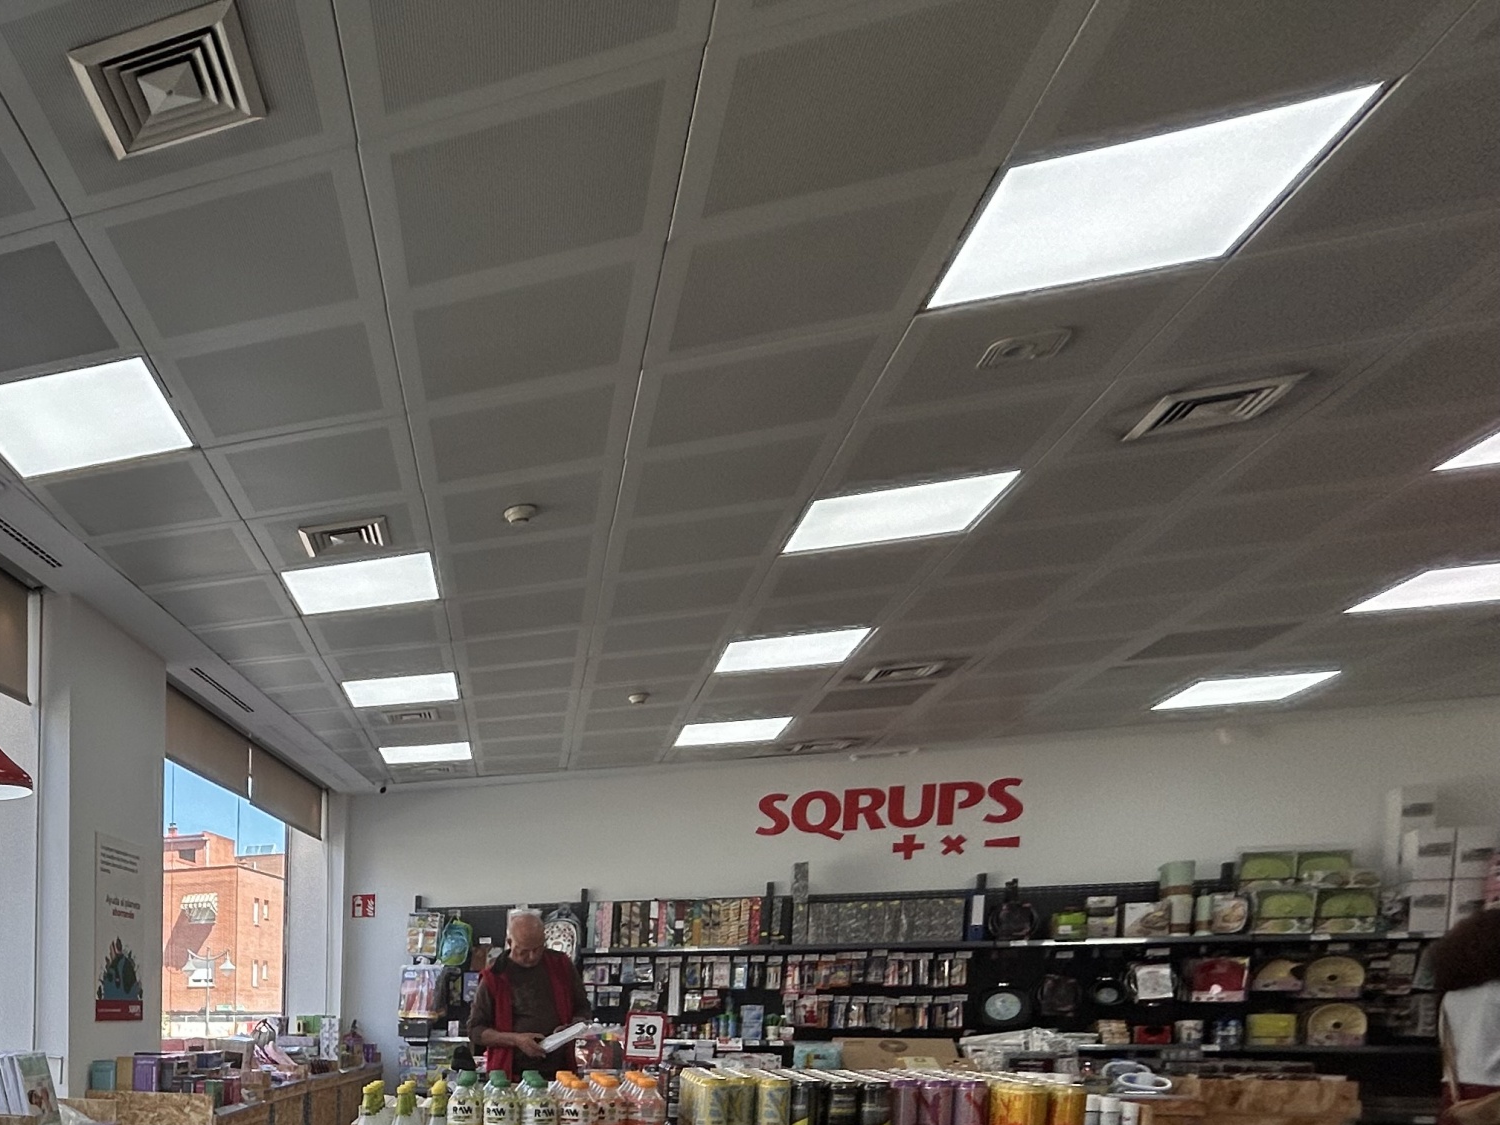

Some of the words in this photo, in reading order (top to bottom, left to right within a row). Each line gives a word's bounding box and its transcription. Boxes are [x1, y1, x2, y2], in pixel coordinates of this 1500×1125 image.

[755, 777, 1024, 841] SQRUPS
[634, 1023, 658, 1037] 30
[452, 1105, 473, 1115] RAW
[486, 1107, 506, 1117] RAW
[534, 1108, 555, 1118] RAW
